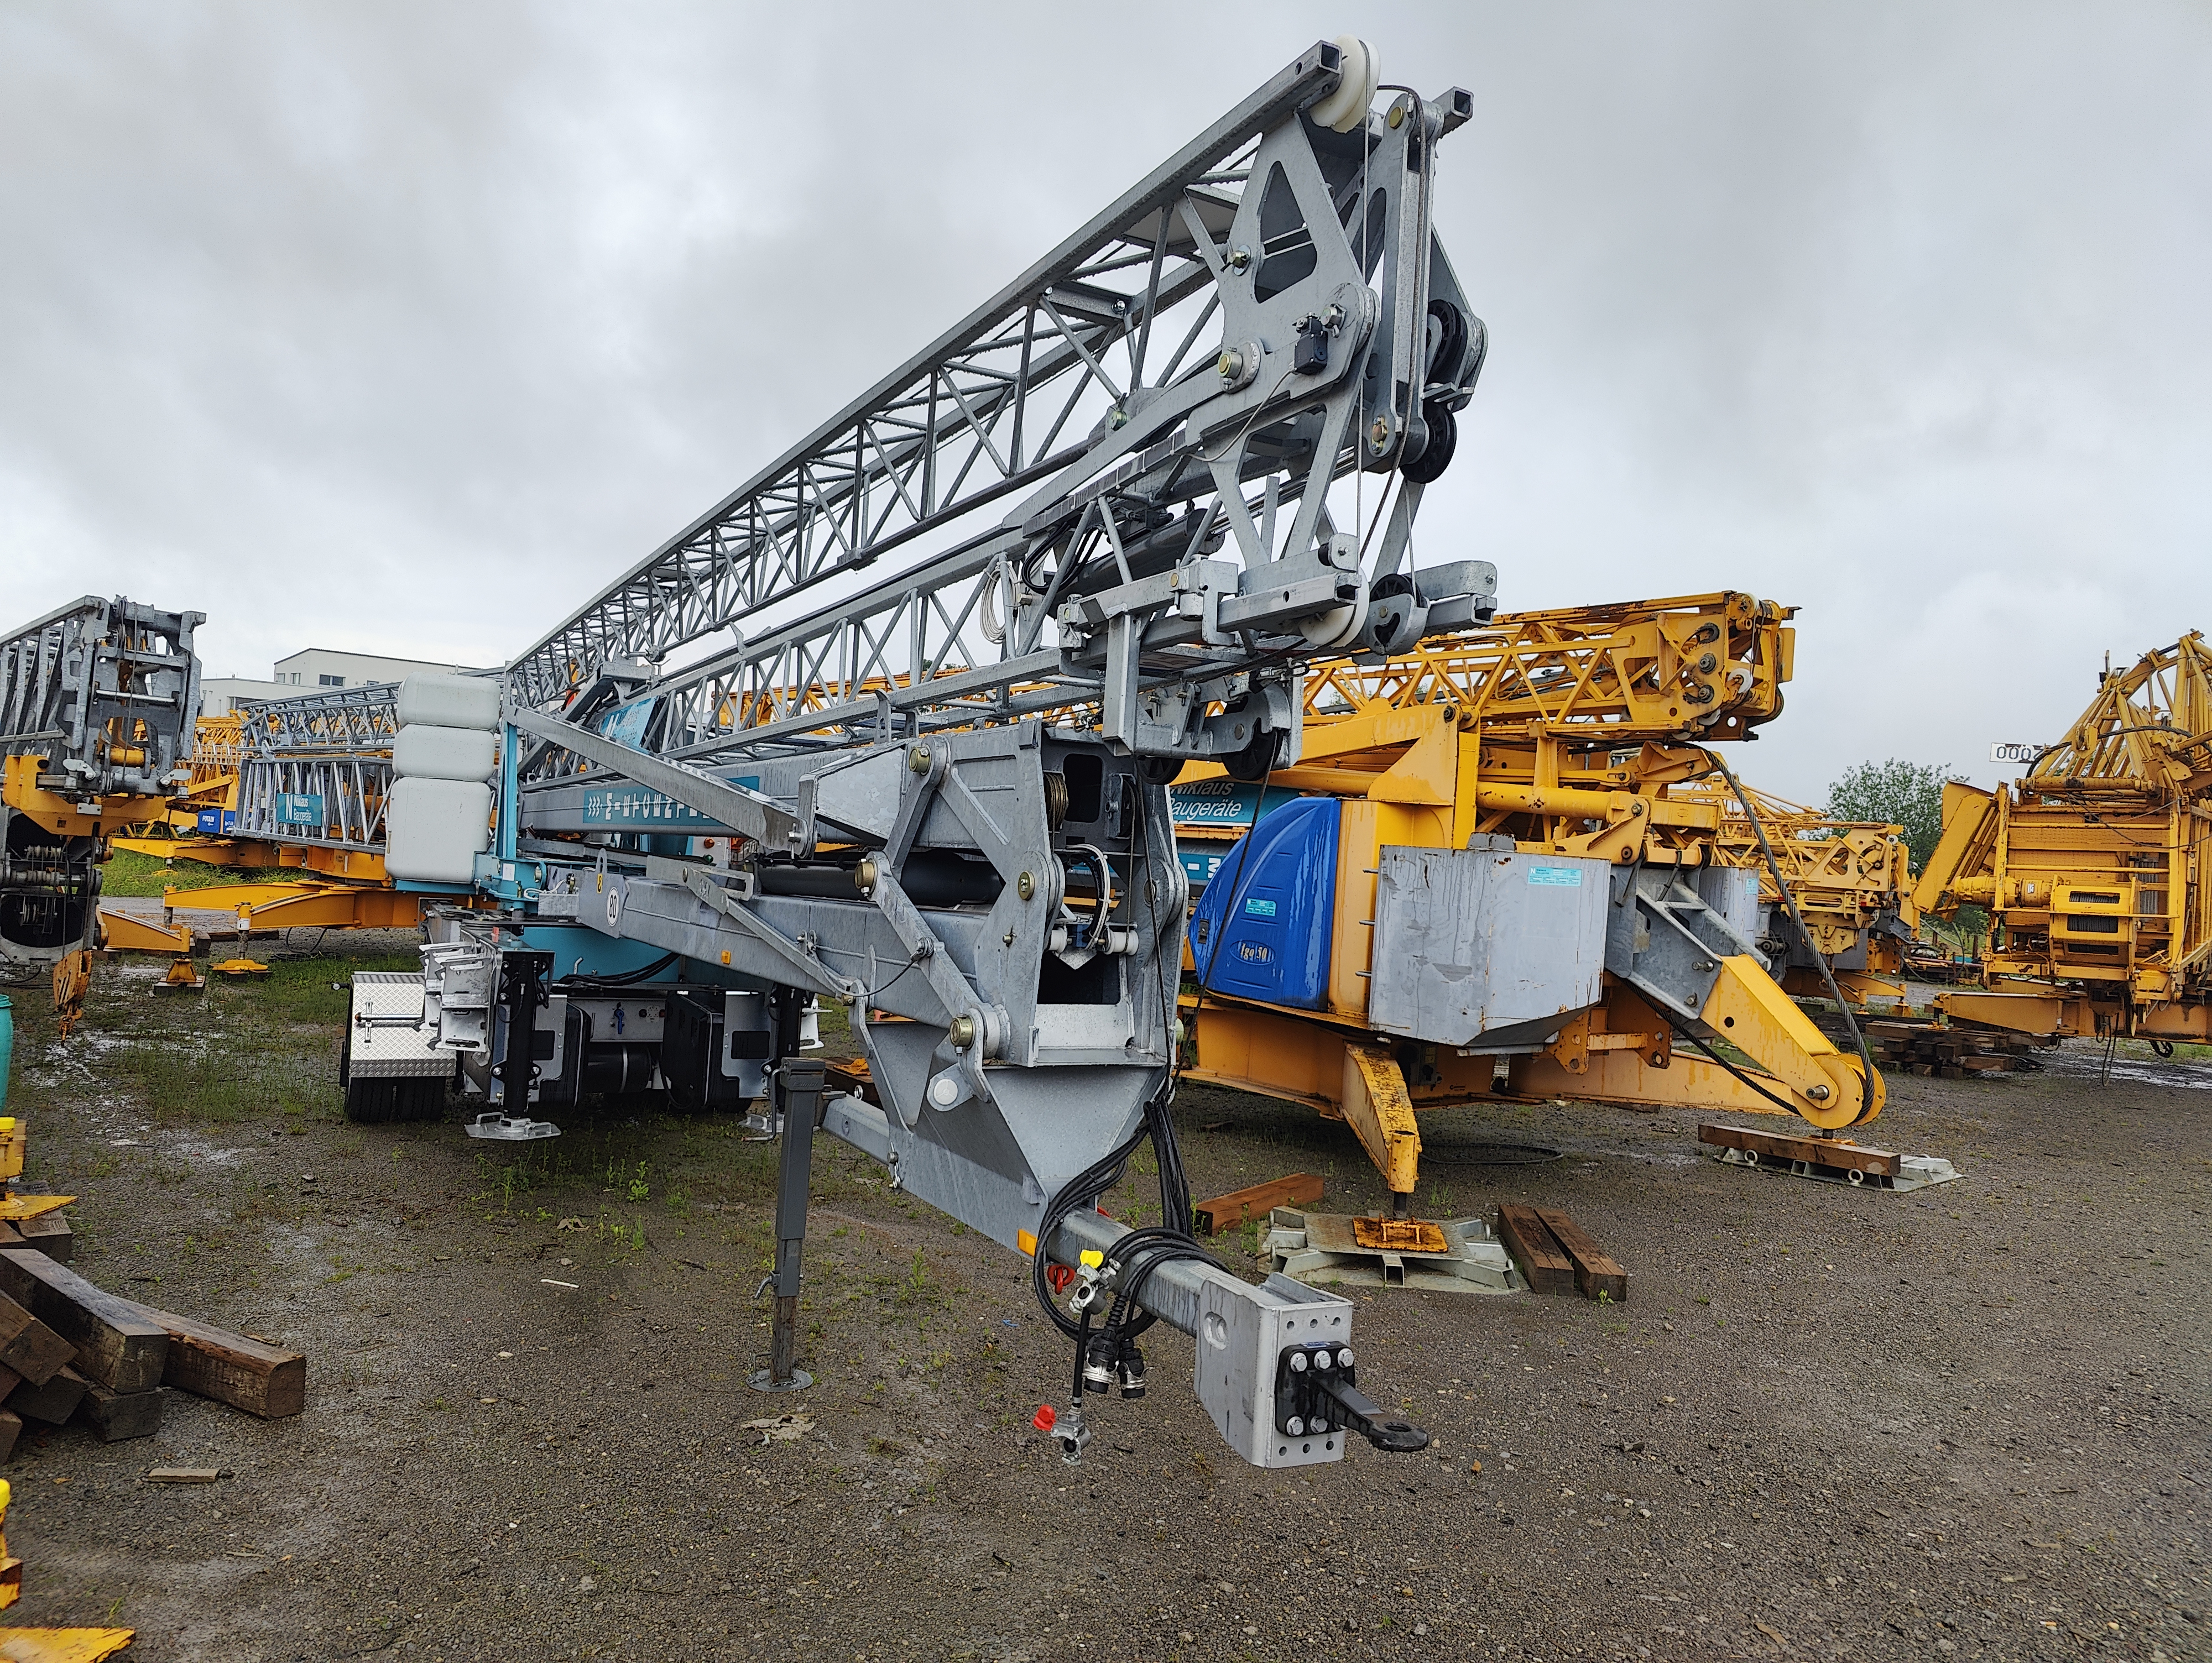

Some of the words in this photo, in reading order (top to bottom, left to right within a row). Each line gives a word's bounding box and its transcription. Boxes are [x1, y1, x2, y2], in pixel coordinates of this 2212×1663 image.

[285, 794, 293, 820] N
[294, 794, 309, 807] Niklaus
[294, 808, 312, 824] Baugeräte
[609, 895, 617, 919] 80
[1240, 943, 1255, 959] Igo
[1256, 946, 1267, 960] 50
